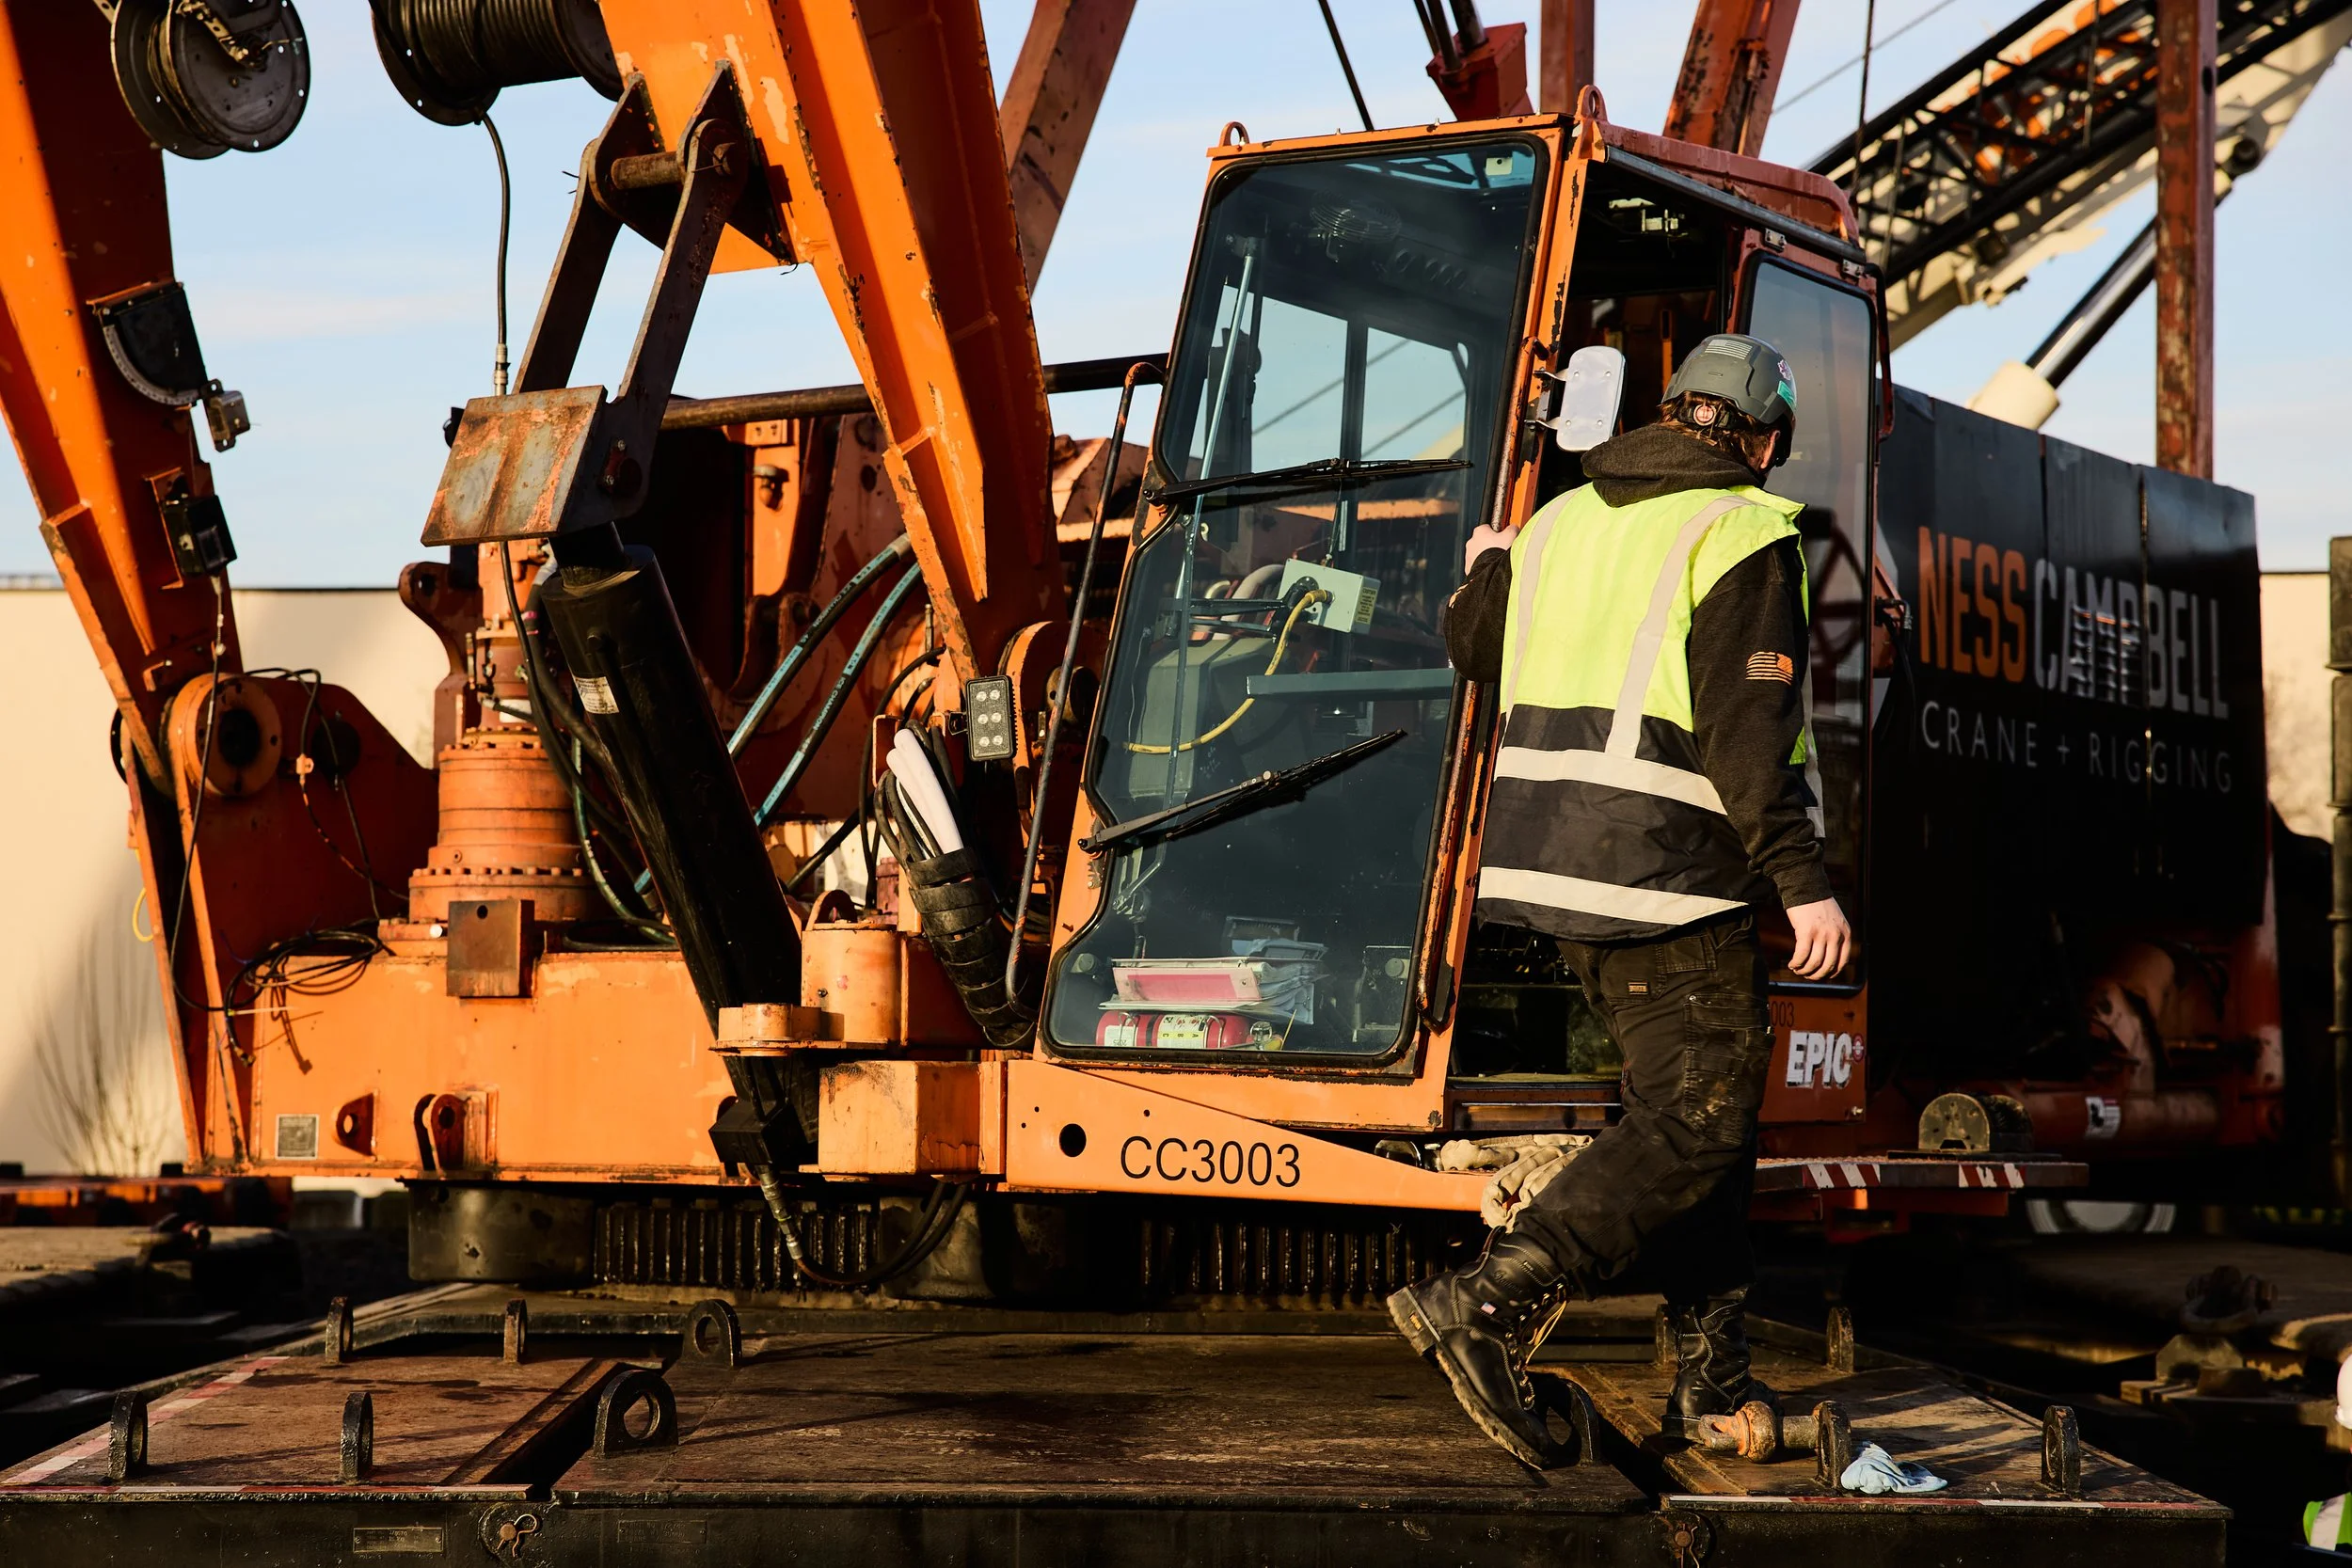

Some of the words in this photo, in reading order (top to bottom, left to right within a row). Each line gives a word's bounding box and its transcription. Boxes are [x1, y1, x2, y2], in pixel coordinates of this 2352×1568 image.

[1918, 526, 2026, 683] NESS
[2034, 559, 2229, 719] CAMPBELL
[1922, 701, 2037, 768] CRANE
[2090, 733, 2232, 794] RIGGING
[1786, 1029, 1853, 1088] EPIC
[1120, 1135, 1300, 1188] CC3003
